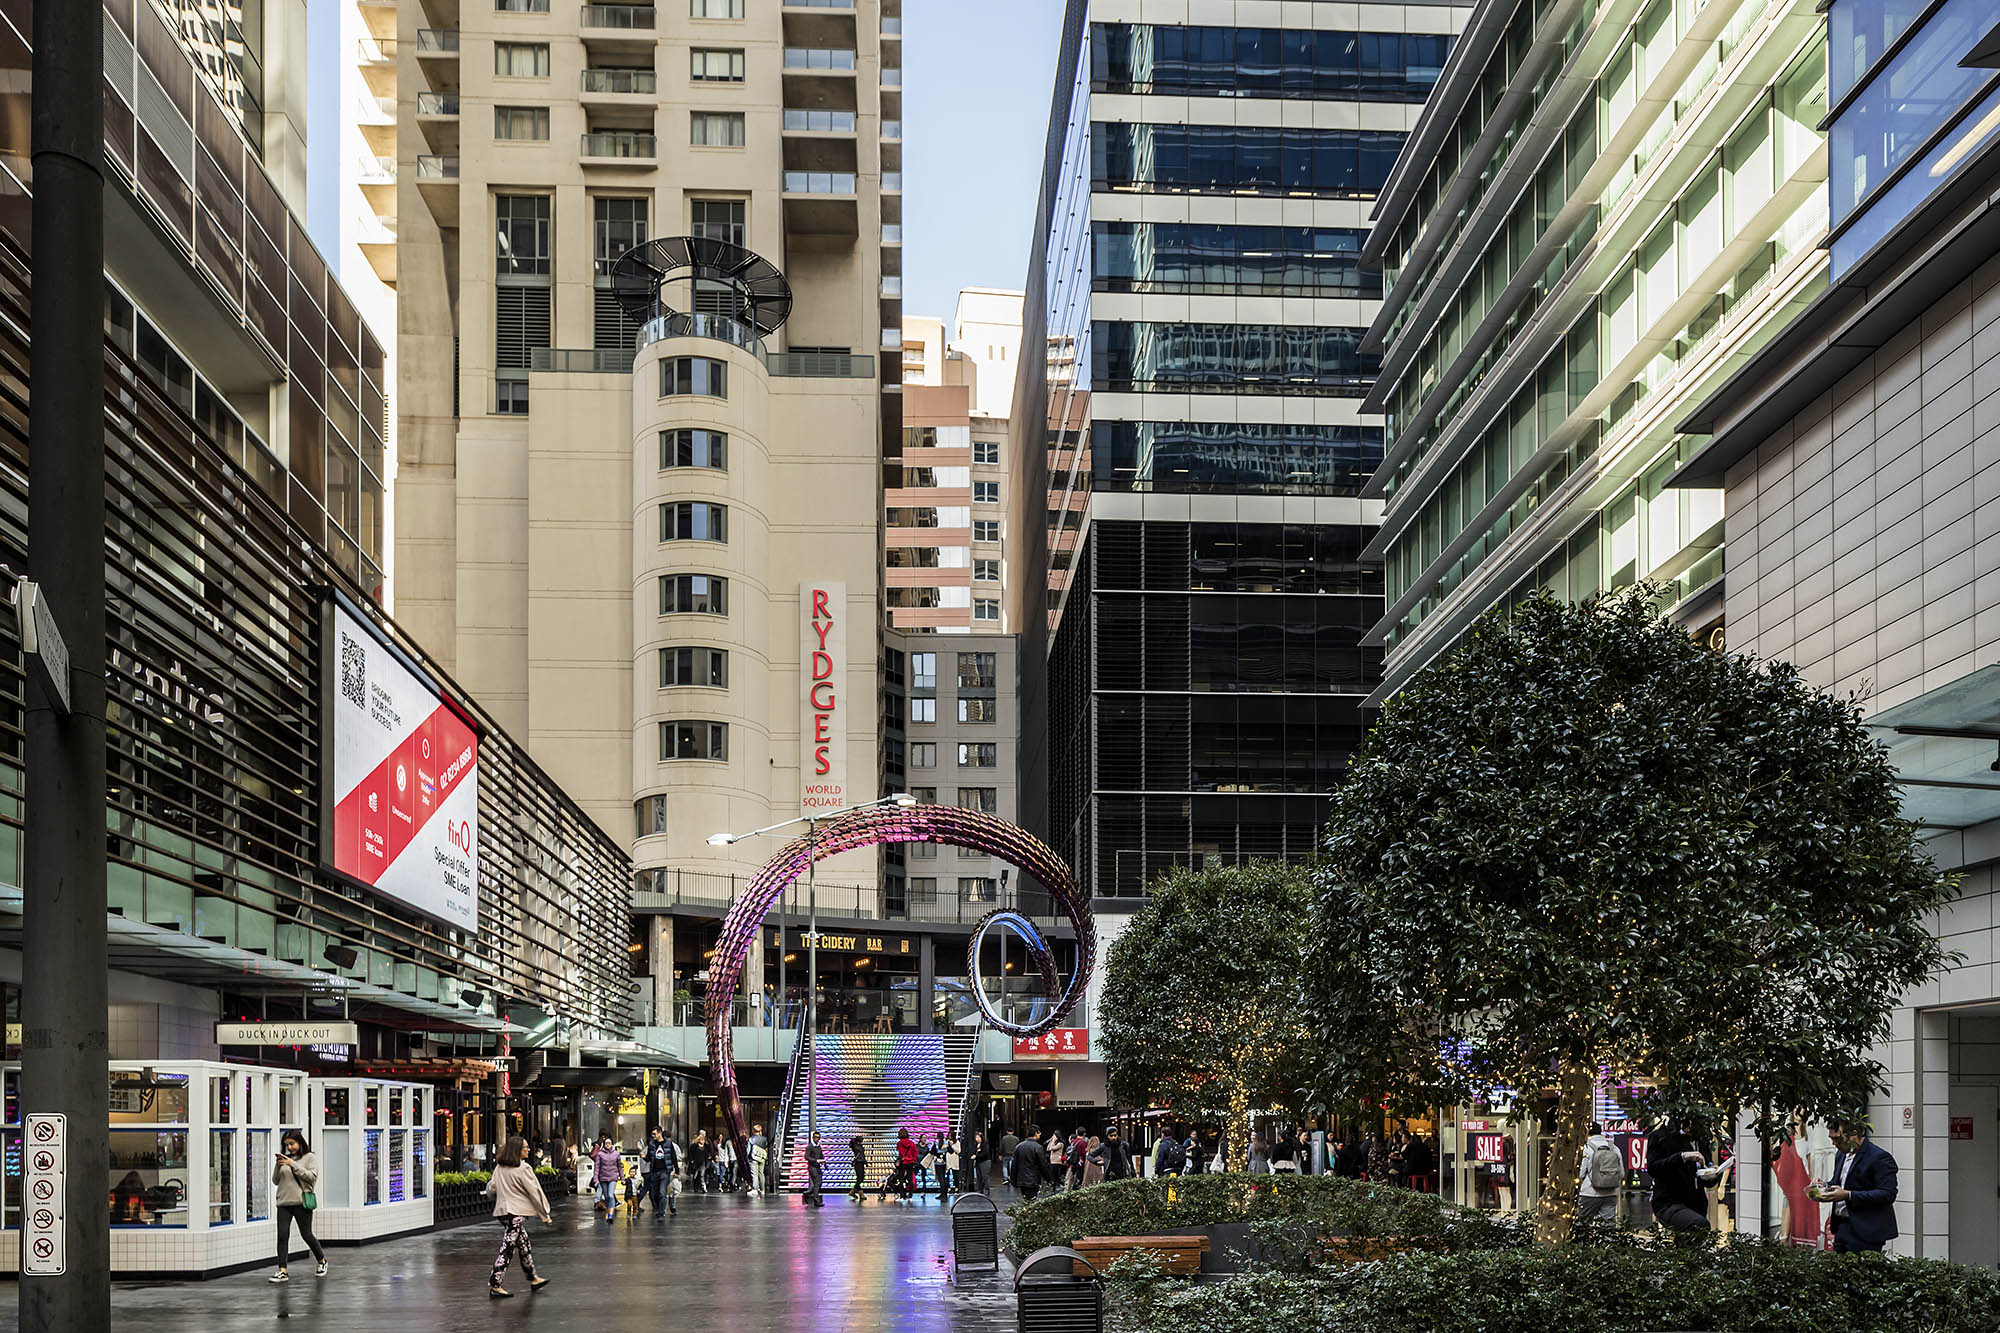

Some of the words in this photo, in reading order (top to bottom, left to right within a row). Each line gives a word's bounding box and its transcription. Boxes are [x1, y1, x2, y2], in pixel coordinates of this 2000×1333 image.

[811, 589, 835, 776] RYDGES
[371, 694, 384, 710] YOUR
[384, 704, 401, 726] FUTURE
[440, 772, 448, 789] 02
[447, 758, 460, 782] 8234
[803, 798, 843, 807] SQUARE
[805, 785, 842, 794] WORLD
[448, 819, 470, 859] finQ
[434, 846, 456, 870] Special
[456, 858, 470, 878] Offer
[443, 870, 456, 890] SME
[456, 876, 471, 896] Loan
[822, 935, 856, 950] CIDERY
[867, 938, 882, 948] BAR
[238, 1029, 266, 1039] DUCK
[268, 1029, 279, 1039] IN
[282, 1029, 310, 1039] DUCK
[312, 1029, 330, 1039] OUT
[1477, 1136, 1501, 1161] SALE
[1631, 1138, 1648, 1169] SA
